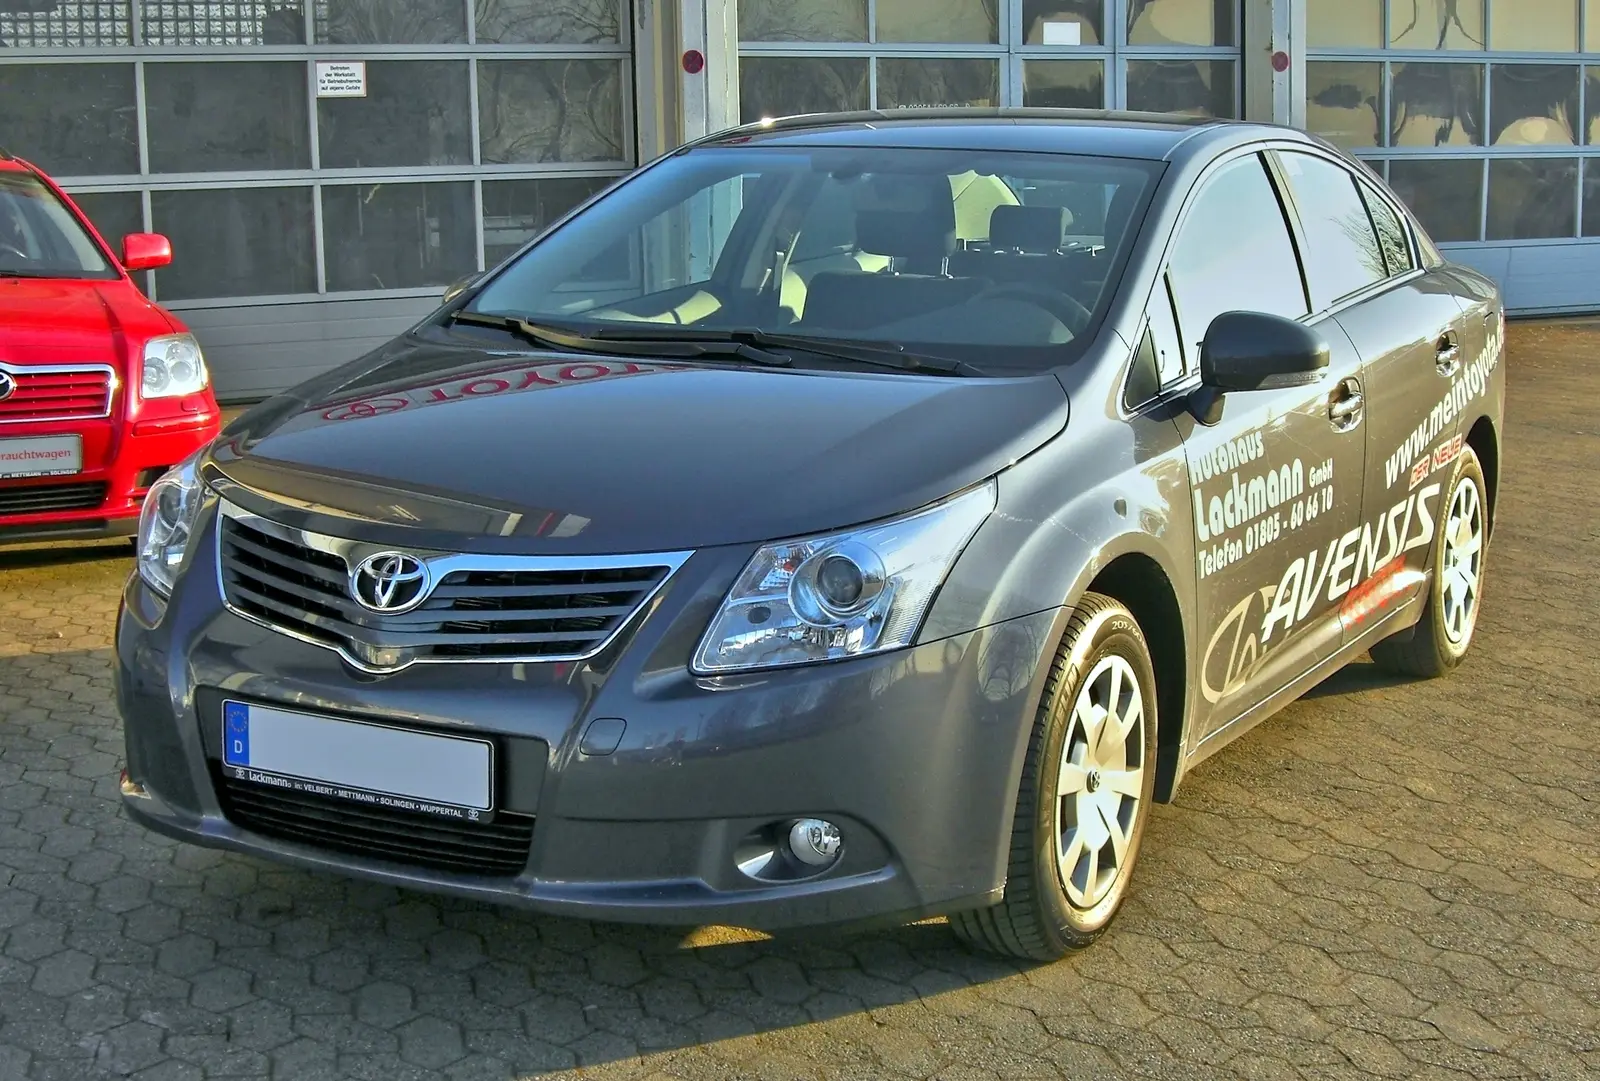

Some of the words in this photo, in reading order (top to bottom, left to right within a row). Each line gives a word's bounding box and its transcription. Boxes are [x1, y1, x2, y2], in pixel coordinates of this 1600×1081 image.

[0, 450, 71, 460] rauchtwagen
[1430, 433, 1463, 473] NEUE
[1194, 458, 1304, 542] Lackmann
[1309, 458, 1333, 488] GmbH
[1198, 537, 1243, 580] Telefon
[1245, 512, 1280, 555] 01805
[1290, 500, 1304, 530] 60
[1305, 492, 1319, 522] 66
[1321, 484, 1334, 513] 10
[1260, 482, 1441, 644] AVENSIS
[234, 739, 243, 754] D
[249, 770, 288, 788] Lackmann
[303, 784, 334, 796] VELBERT
[338, 789, 376, 803] METTMANN
[380, 797, 415, 810] SOLINGEN
[419, 803, 463, 818] WUPPERTAL
